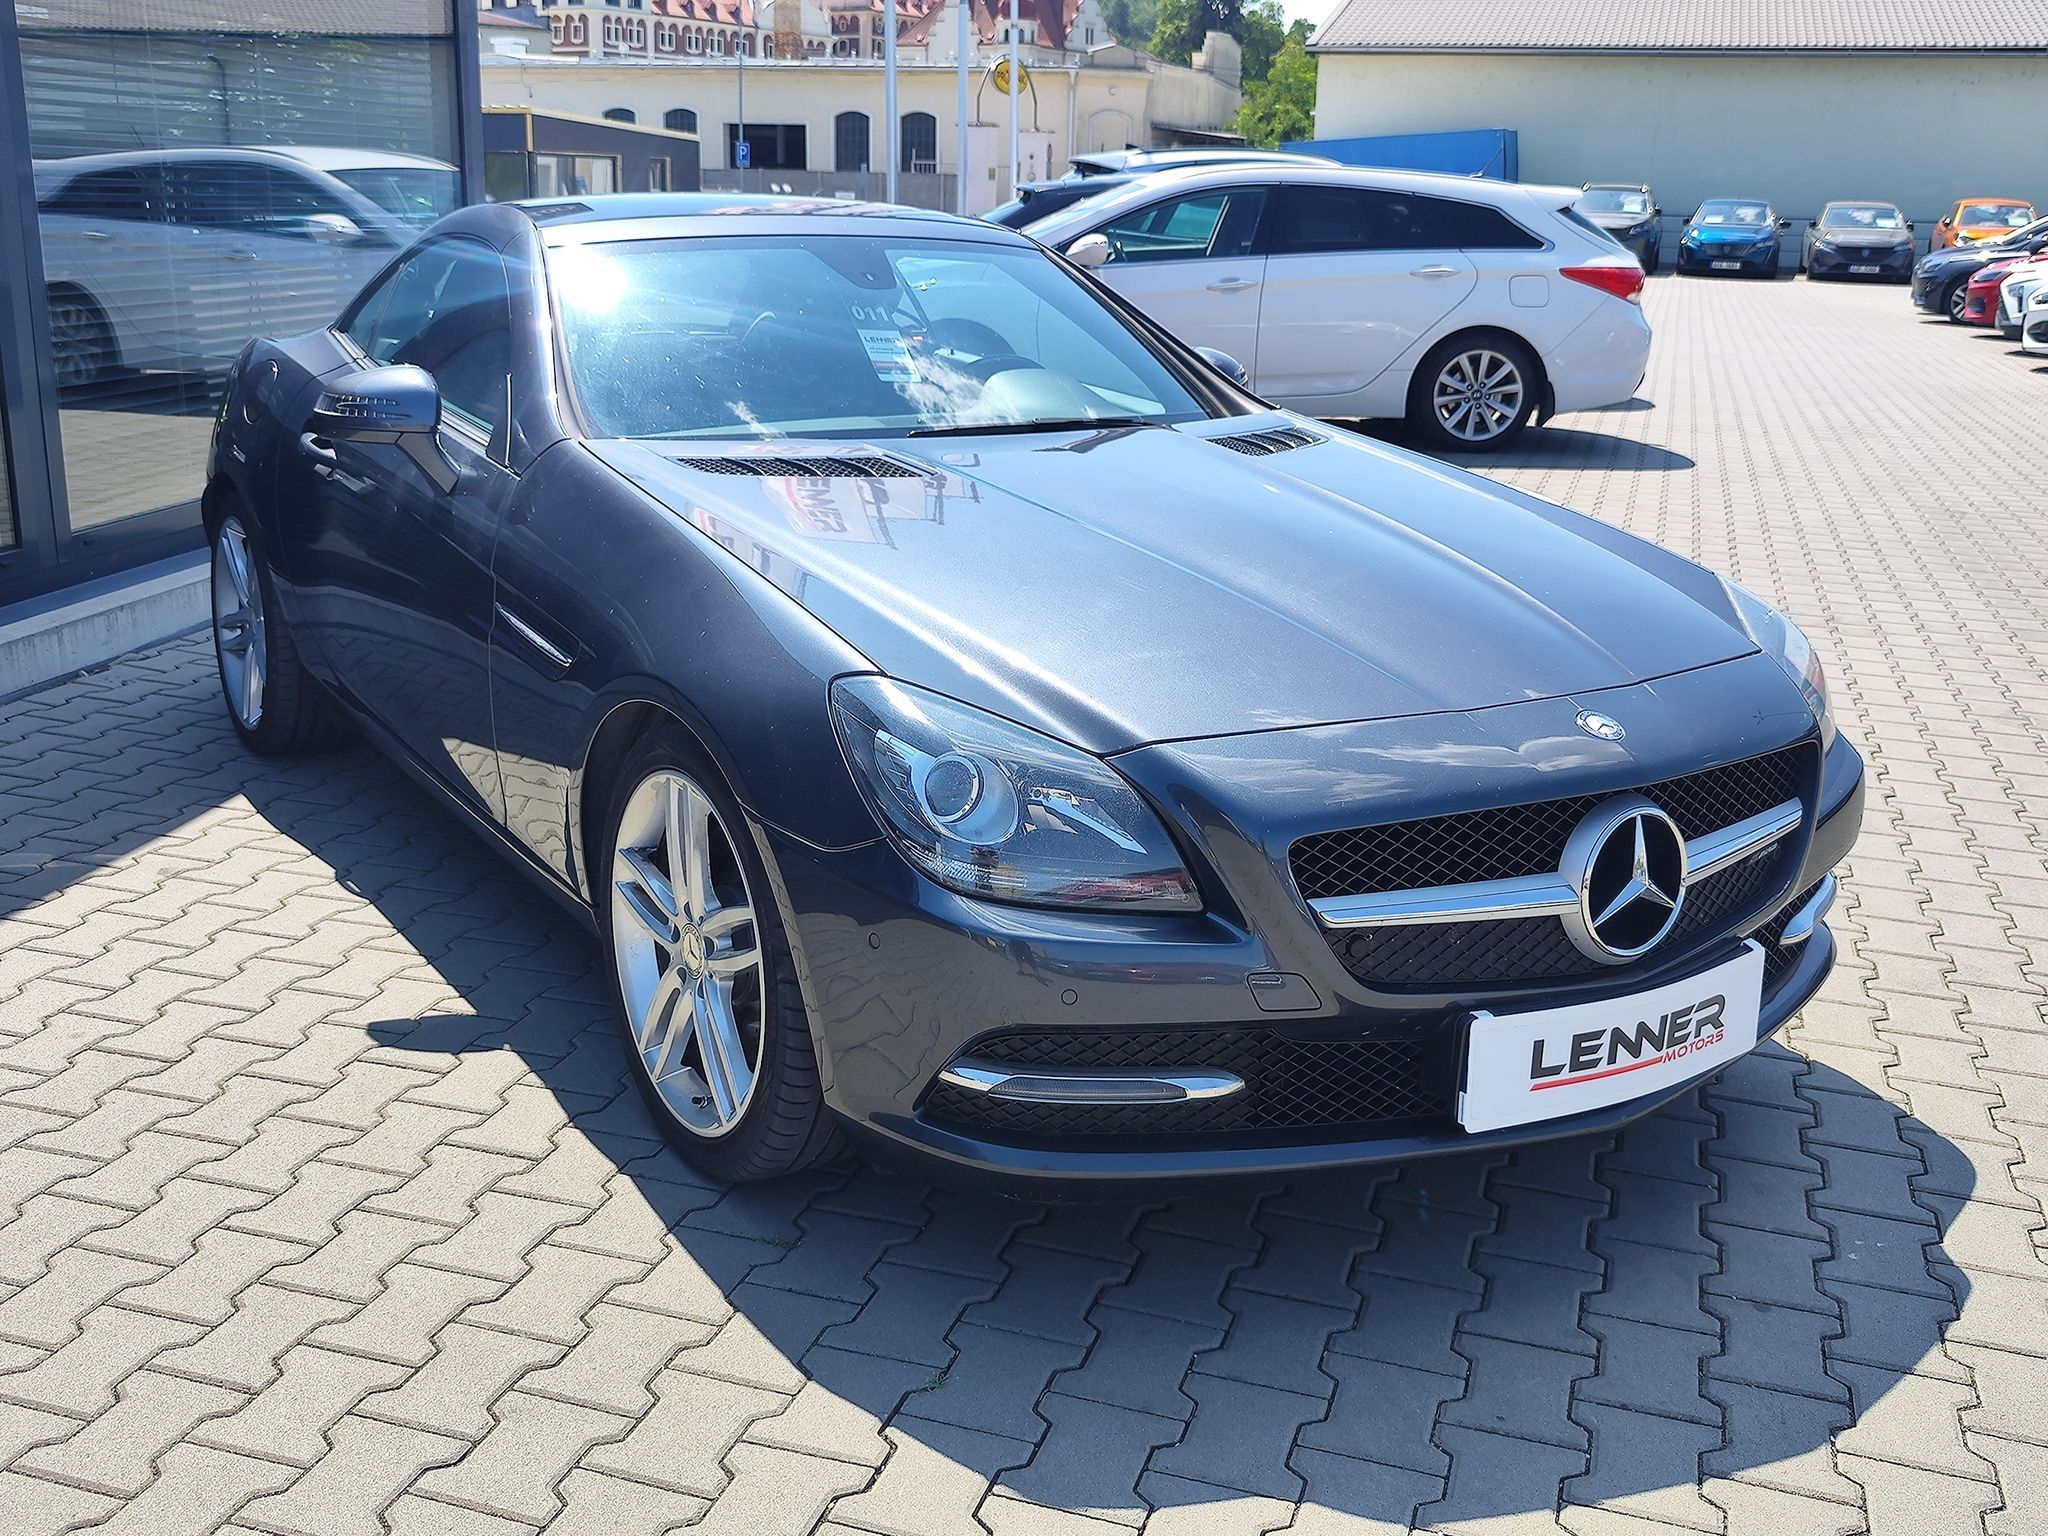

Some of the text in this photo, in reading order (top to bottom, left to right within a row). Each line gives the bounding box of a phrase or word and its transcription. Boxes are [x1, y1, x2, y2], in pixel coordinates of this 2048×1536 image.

[739, 145, 748, 160] P
[1530, 994, 1726, 1080] LENNER
[1662, 1029, 1725, 1064] MOTORS
